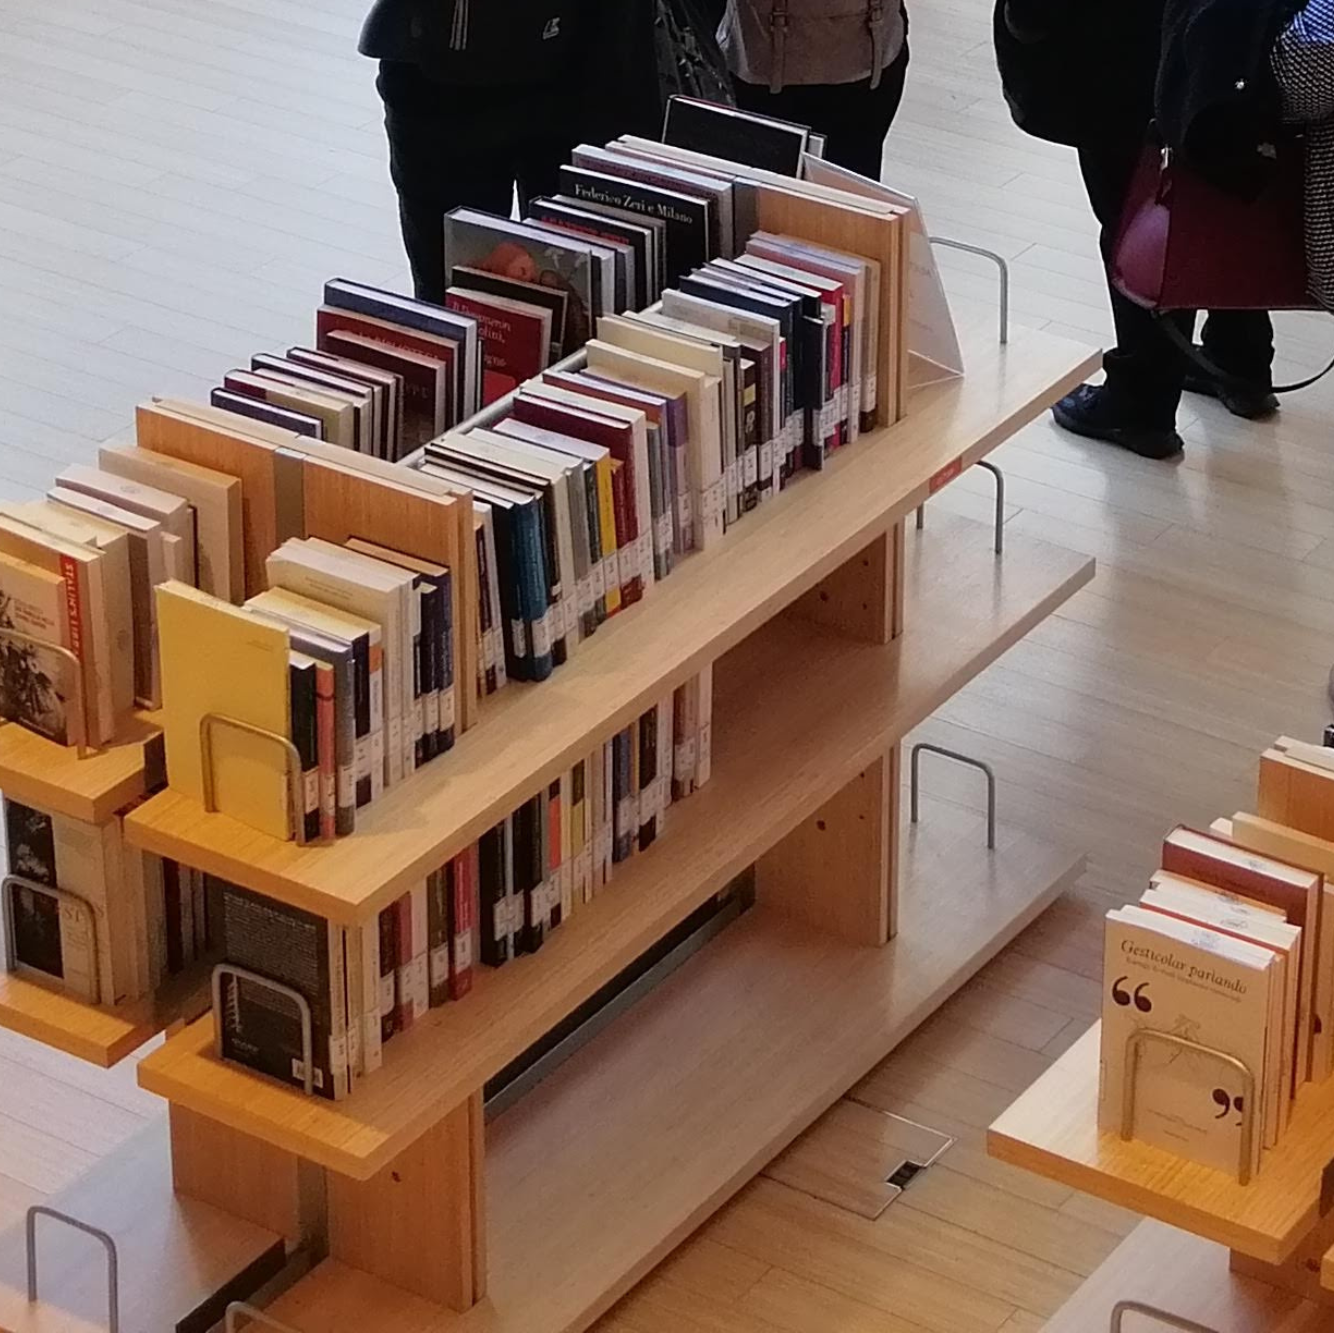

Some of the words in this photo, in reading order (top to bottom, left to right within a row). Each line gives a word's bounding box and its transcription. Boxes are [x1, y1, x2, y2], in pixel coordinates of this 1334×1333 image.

[574, 183, 621, 205] Federico
[622, 194, 646, 212] Zeri
[656, 203, 693, 224] Milano
[1121, 939, 1186, 970] Gesticolar
[1188, 966, 1248, 995] parlando
